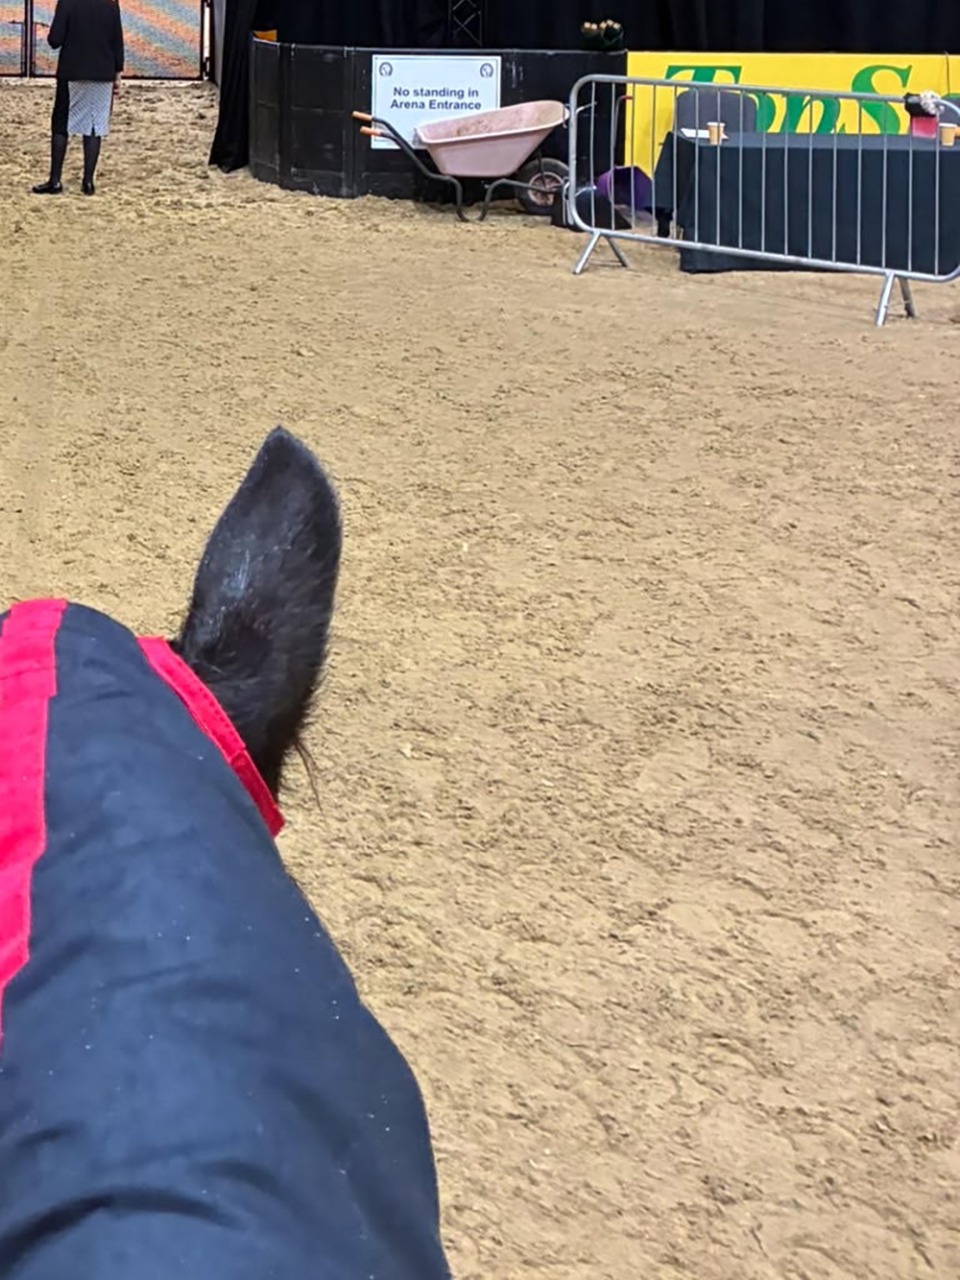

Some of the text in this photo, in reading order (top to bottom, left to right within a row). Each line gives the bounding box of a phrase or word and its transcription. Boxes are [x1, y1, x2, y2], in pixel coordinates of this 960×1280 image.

[393, 87, 479, 99] No standing in
[390, 99, 482, 110] Arena Entrance
